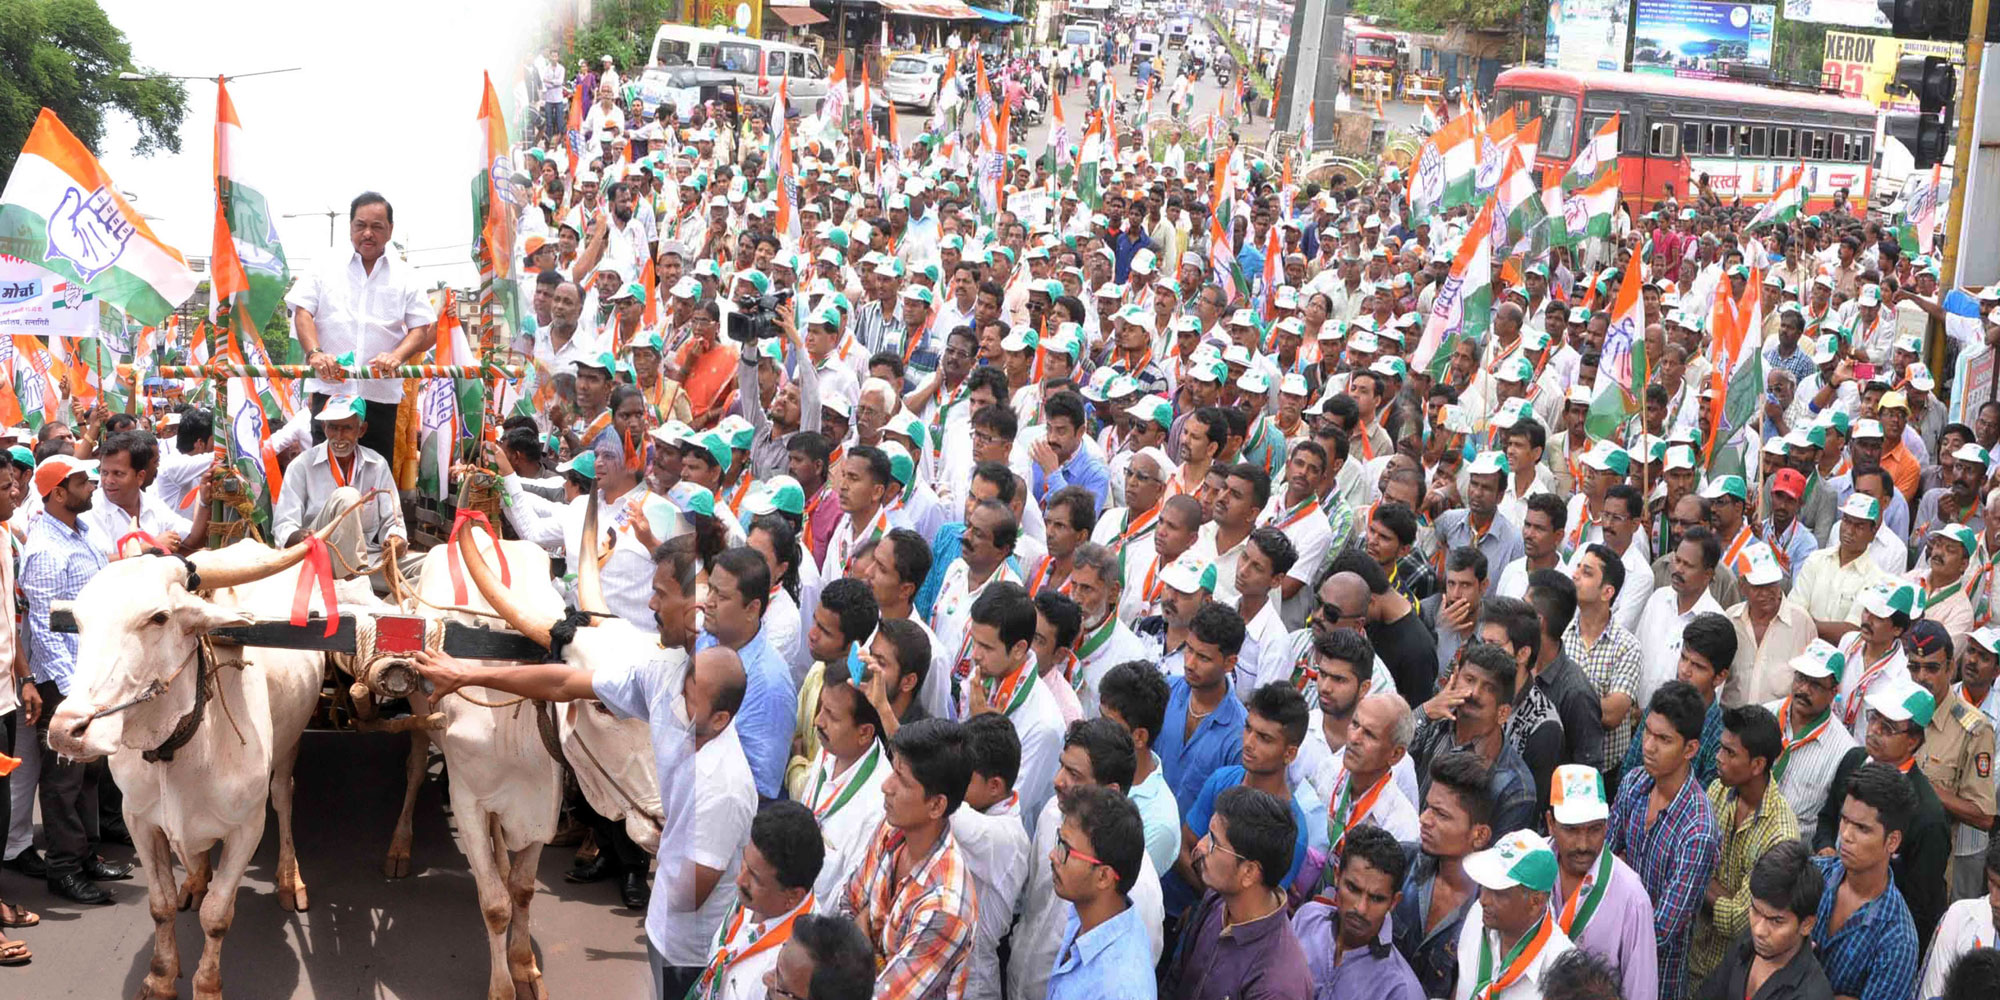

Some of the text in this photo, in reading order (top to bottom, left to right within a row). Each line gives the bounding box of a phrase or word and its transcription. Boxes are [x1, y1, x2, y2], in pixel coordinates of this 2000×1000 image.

[1825, 35, 1875, 63] XEROX
[1904, 43, 1930, 52] DIGITAL
[2, 282, 35, 298] मोर्चा
